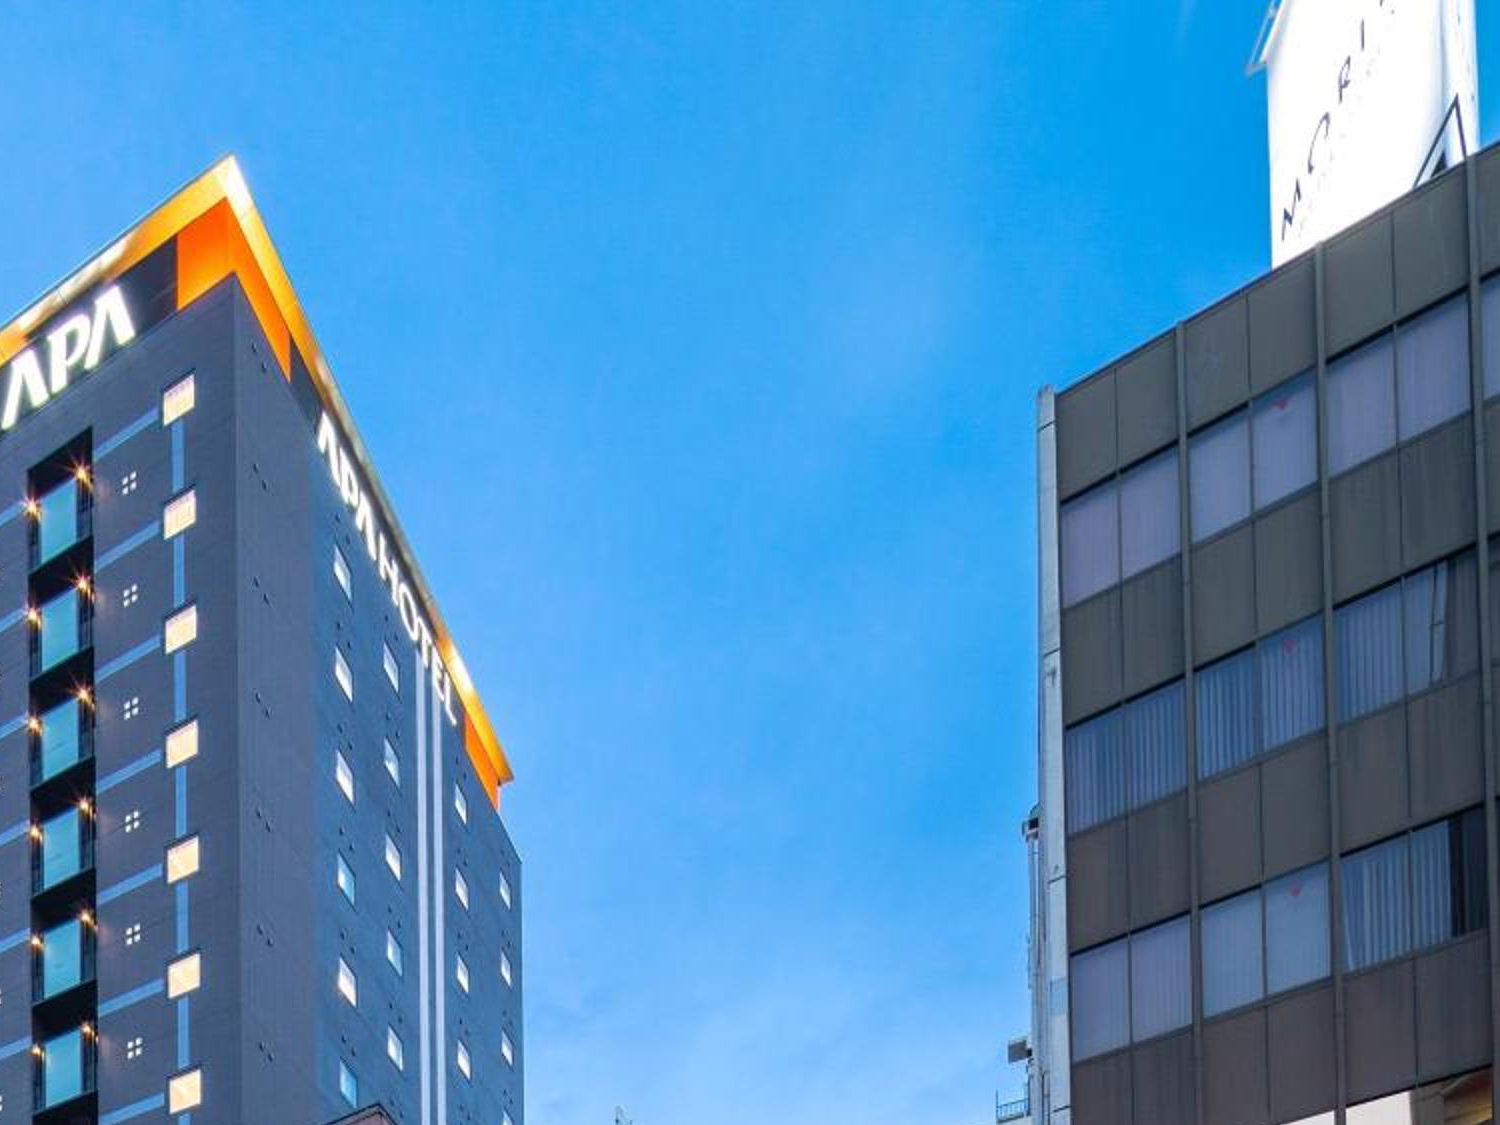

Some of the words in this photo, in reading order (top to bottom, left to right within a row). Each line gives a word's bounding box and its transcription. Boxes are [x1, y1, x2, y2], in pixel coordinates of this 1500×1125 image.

[1281, 0, 1387, 241] MORI
[1, 285, 136, 430] APA
[317, 411, 378, 561] APA
[378, 531, 457, 725] HOTEL
